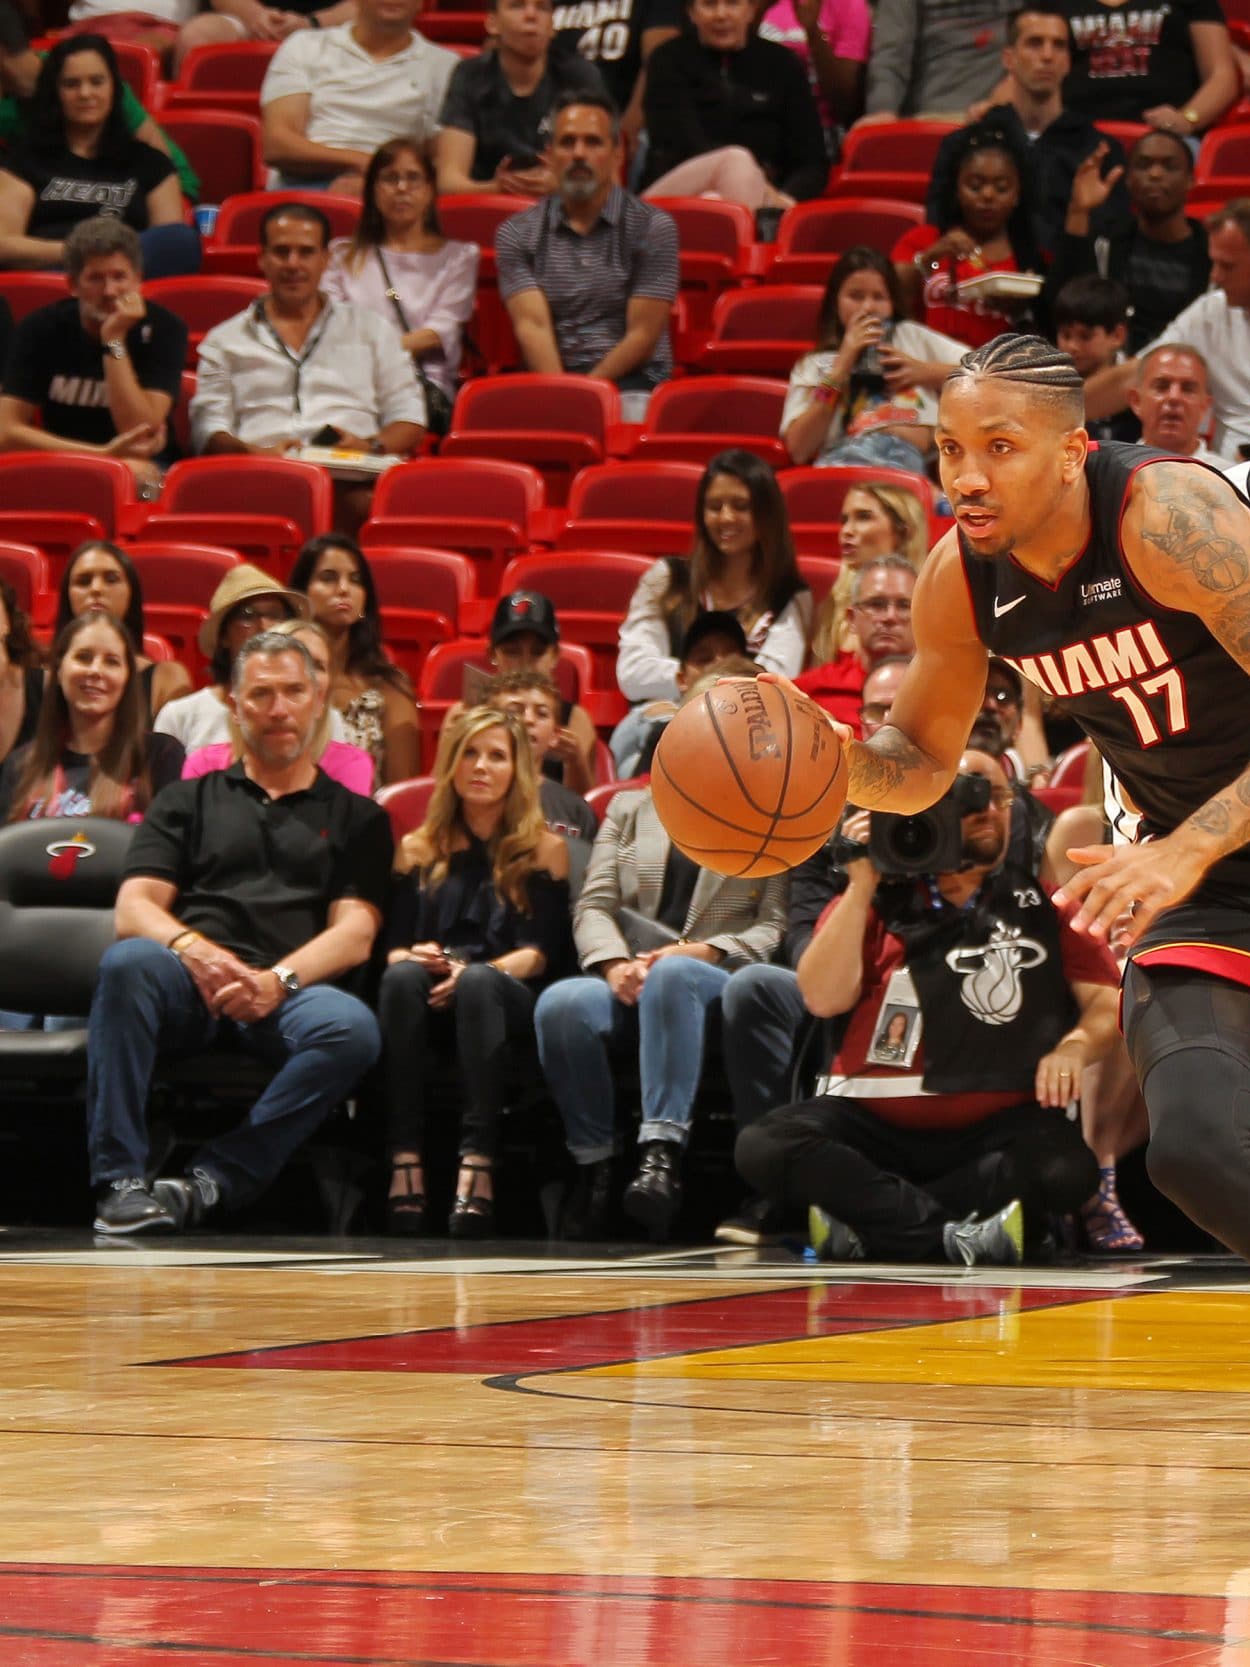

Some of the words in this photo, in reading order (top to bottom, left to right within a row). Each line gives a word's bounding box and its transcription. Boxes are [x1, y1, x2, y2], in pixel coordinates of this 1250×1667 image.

[1001, 620, 1171, 697] MIAMI
[1111, 668, 1187, 748] 17
[1013, 889, 1041, 908] 23
